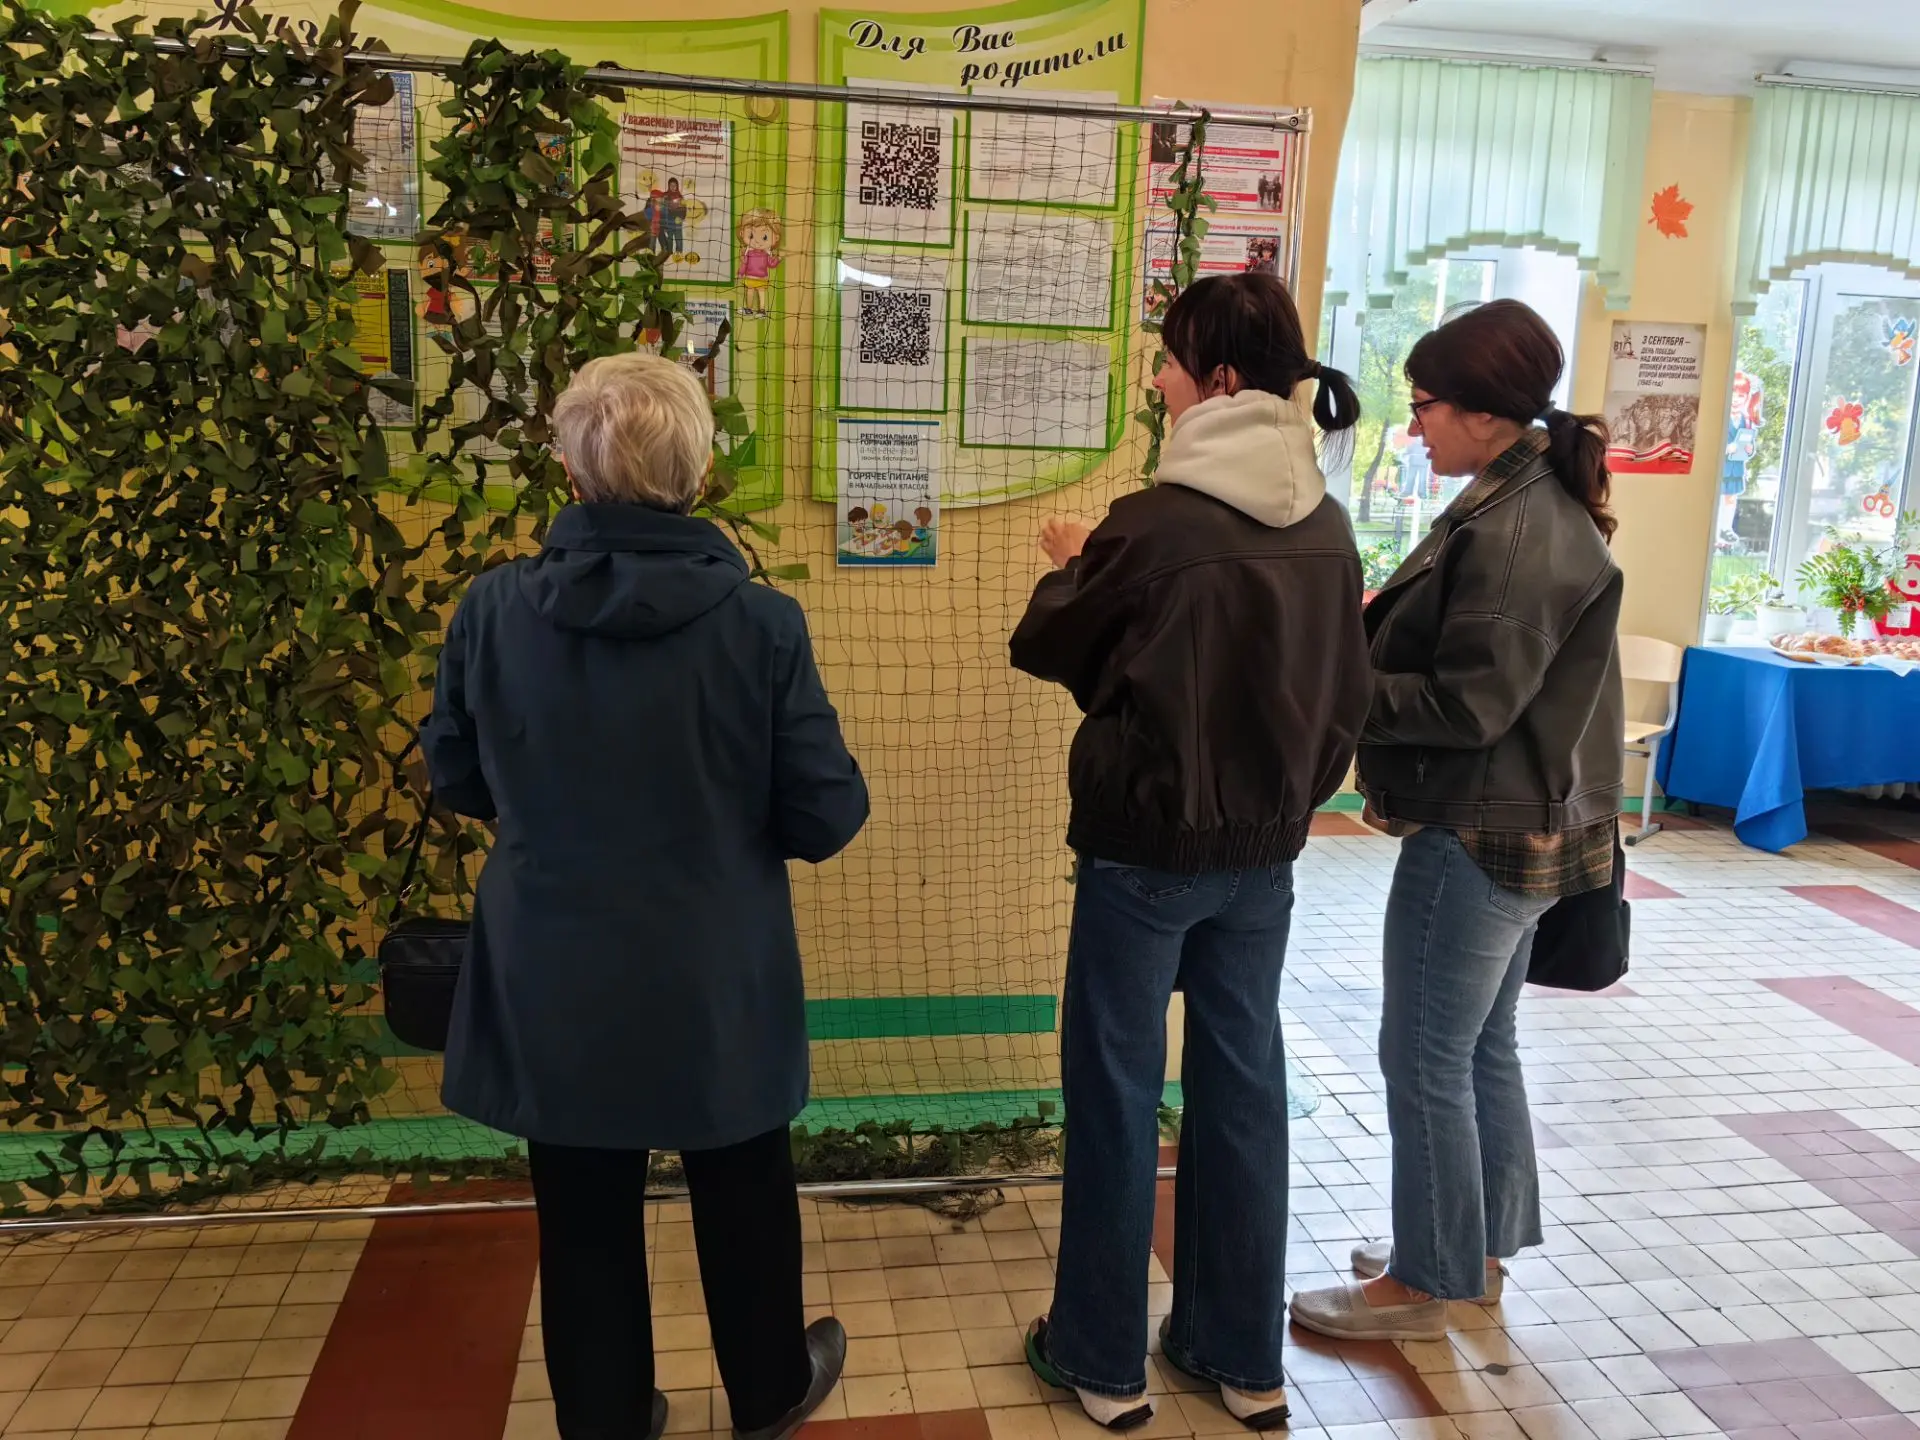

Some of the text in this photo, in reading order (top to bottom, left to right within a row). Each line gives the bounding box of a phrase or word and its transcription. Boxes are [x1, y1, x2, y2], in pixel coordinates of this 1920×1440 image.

[849, 20, 1017, 61] Для Вас
[960, 32, 1128, 88] родители
[623, 112, 674, 128] Уважаемые
[1648, 335, 1684, 346] СЕНТЯБРЯ
[848, 472, 929, 481] ГОРЯЧЕЕ ПИТАНИЕ
[855, 482, 897, 490] НАЧАЛЬНЫХ
